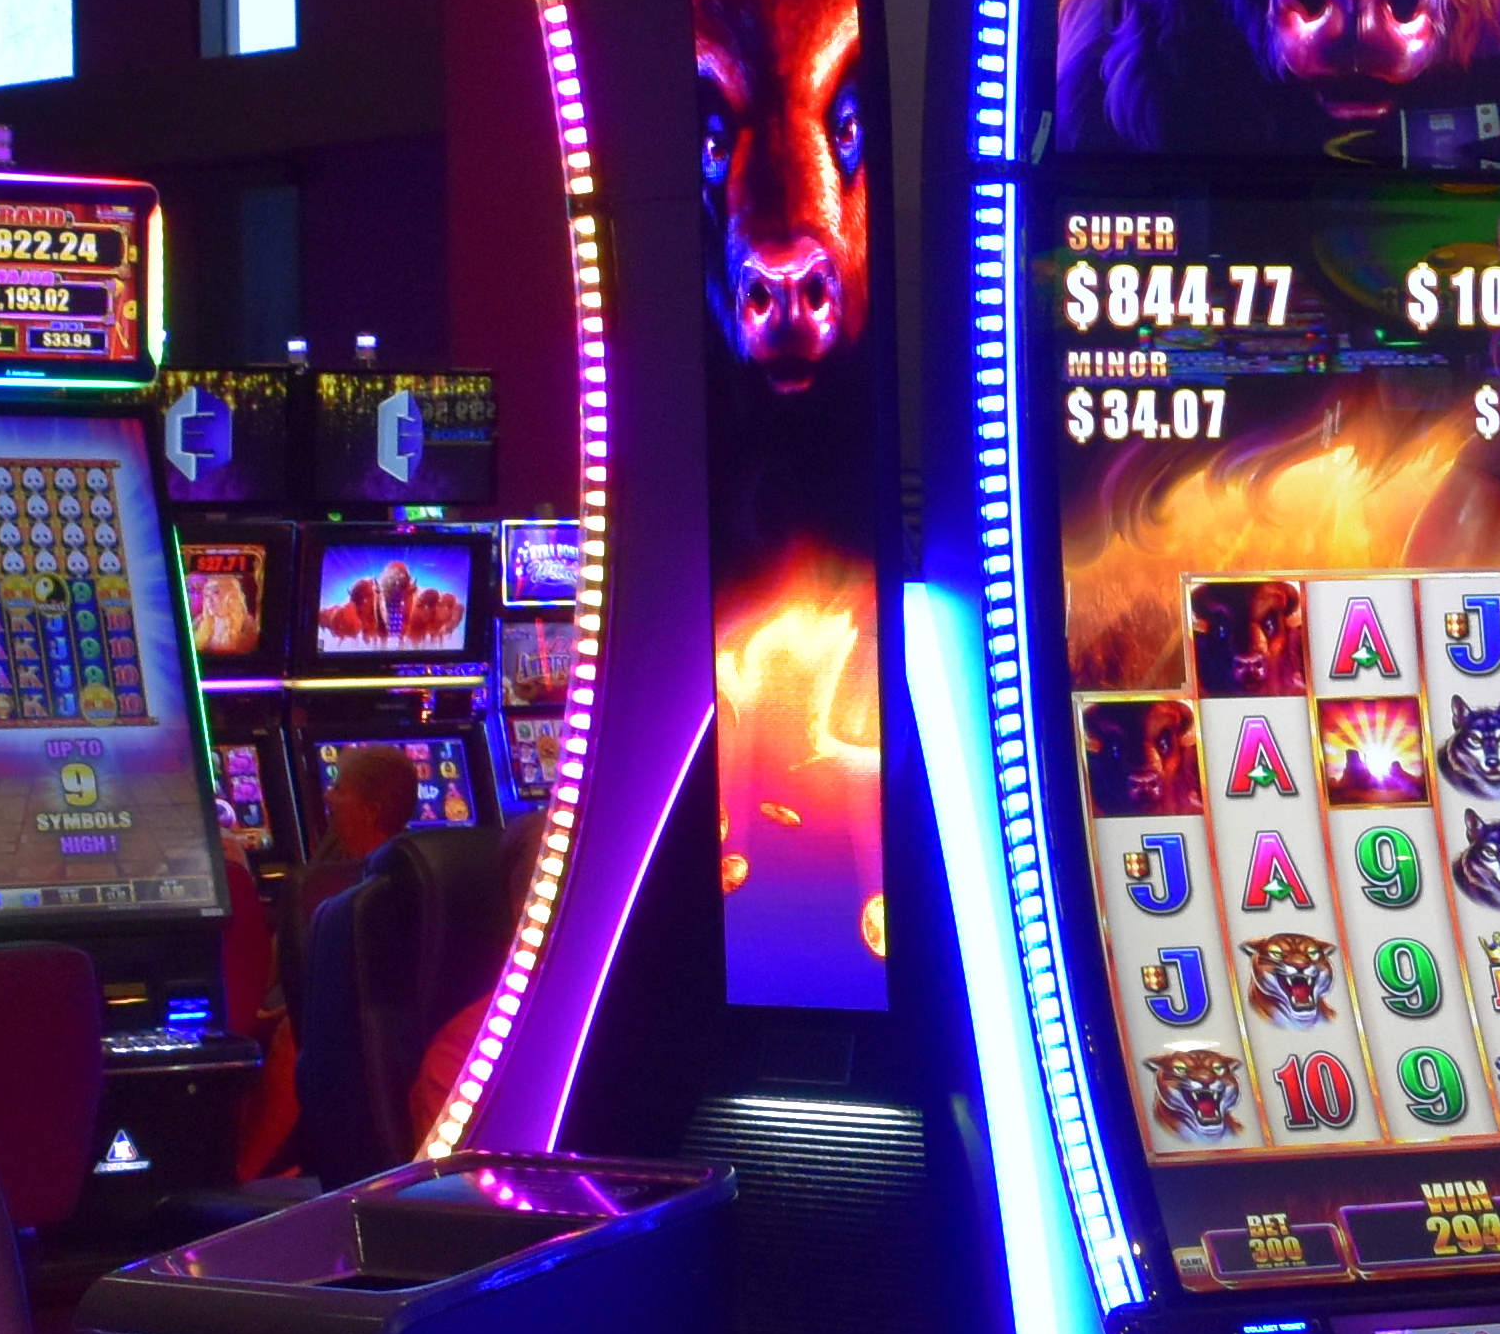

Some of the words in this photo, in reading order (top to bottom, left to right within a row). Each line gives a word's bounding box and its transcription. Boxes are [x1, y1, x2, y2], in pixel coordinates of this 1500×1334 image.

[1067, 215, 1175, 253] SUPER
[42, 332, 92, 348] $33.94
[1067, 351, 1169, 379] MINOR
[46, 740, 72, 757] UP
[76, 739, 101, 757] TO
[60, 762, 98, 806] 9
[37, 811, 132, 831] SYMBOLS
[1421, 1180, 1494, 1213] WIN
[1246, 1212, 1287, 1238] BET
[1248, 1236, 1304, 1263] 300
